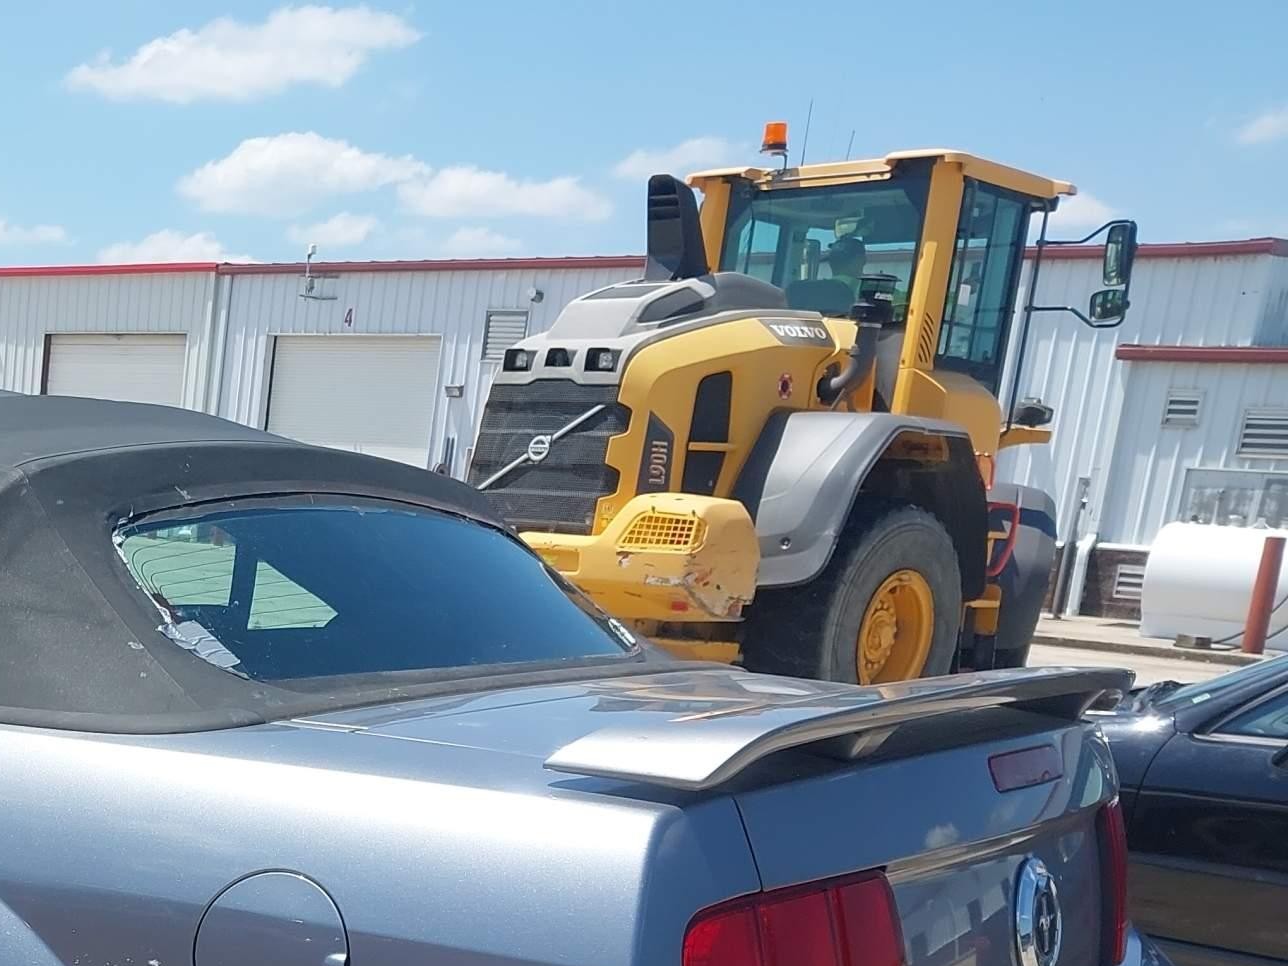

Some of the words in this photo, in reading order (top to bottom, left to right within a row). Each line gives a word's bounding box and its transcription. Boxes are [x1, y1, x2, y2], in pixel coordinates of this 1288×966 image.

[344, 307, 353, 328] 4
[768, 324, 827, 341] VOLVO
[648, 440, 669, 486] L90H
